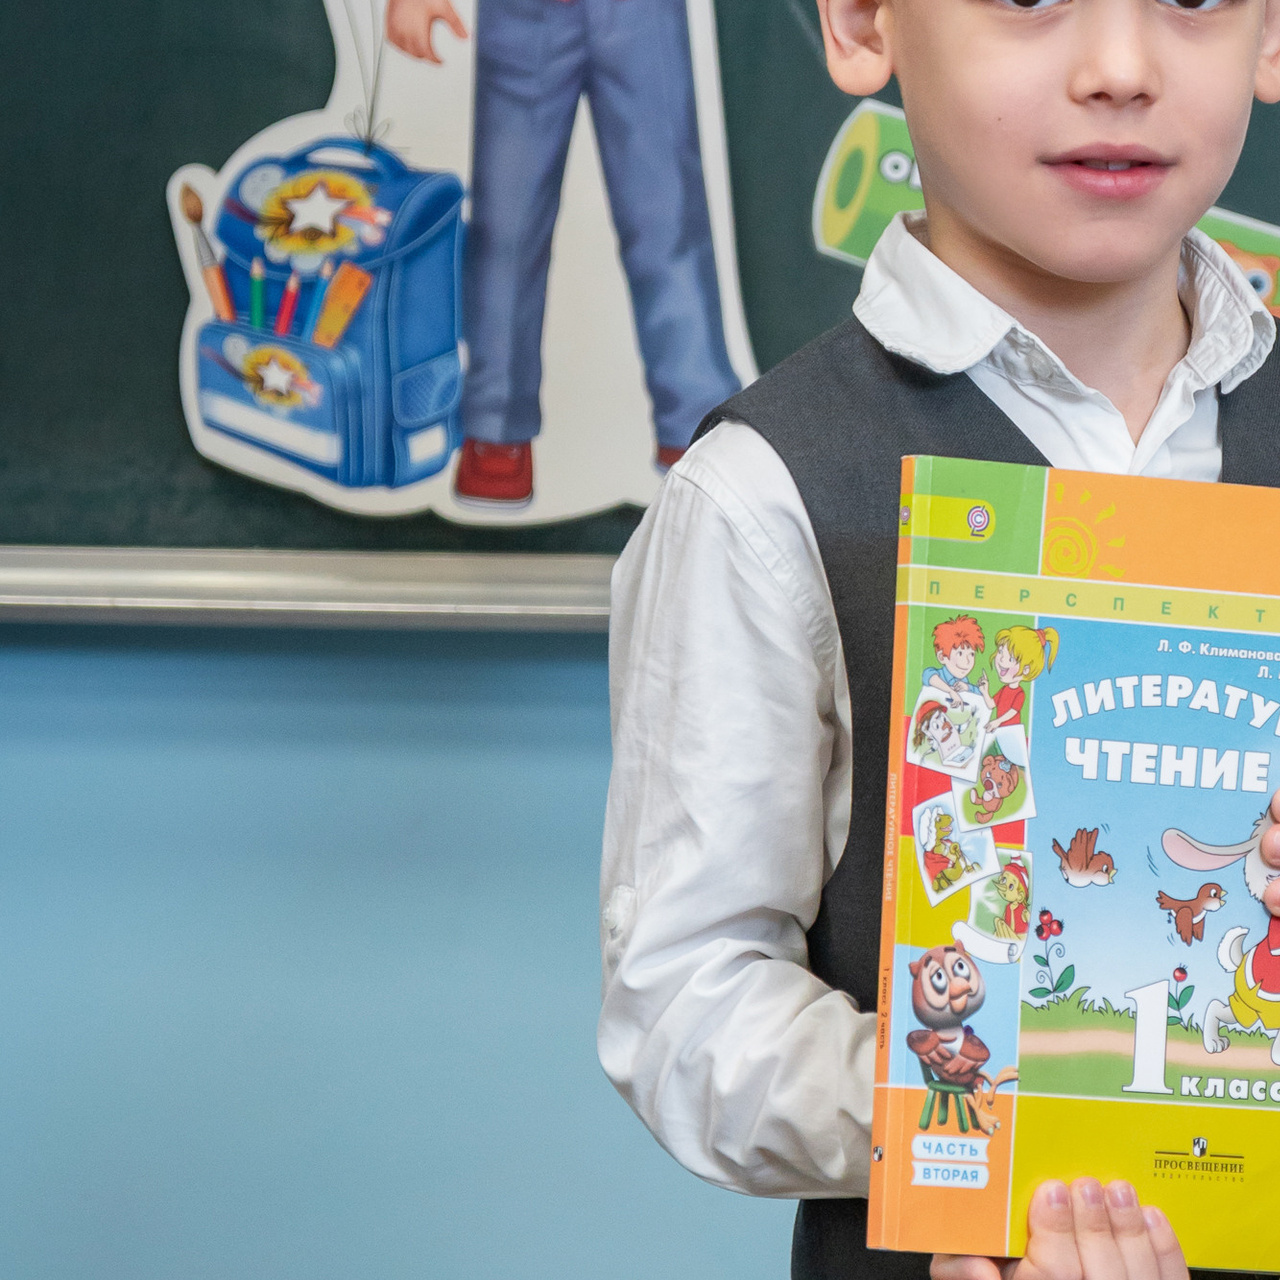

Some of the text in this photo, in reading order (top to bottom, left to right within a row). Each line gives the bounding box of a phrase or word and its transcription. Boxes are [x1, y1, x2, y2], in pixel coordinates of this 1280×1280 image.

[1157, 639, 1172, 652] Л.
[1178, 640, 1195, 655] Ф.
[1257, 666, 1273, 679] Л.
[1065, 737, 1272, 793] ЧТЕНИЕ
[1121, 979, 1174, 1095] 1
[922, 1141, 979, 1157] ЧАСТЬ
[1154, 1159, 1244, 1173] ПРОСВЕЩЕНИЕ
[922, 1167, 979, 1182] ВТОРАЯ
